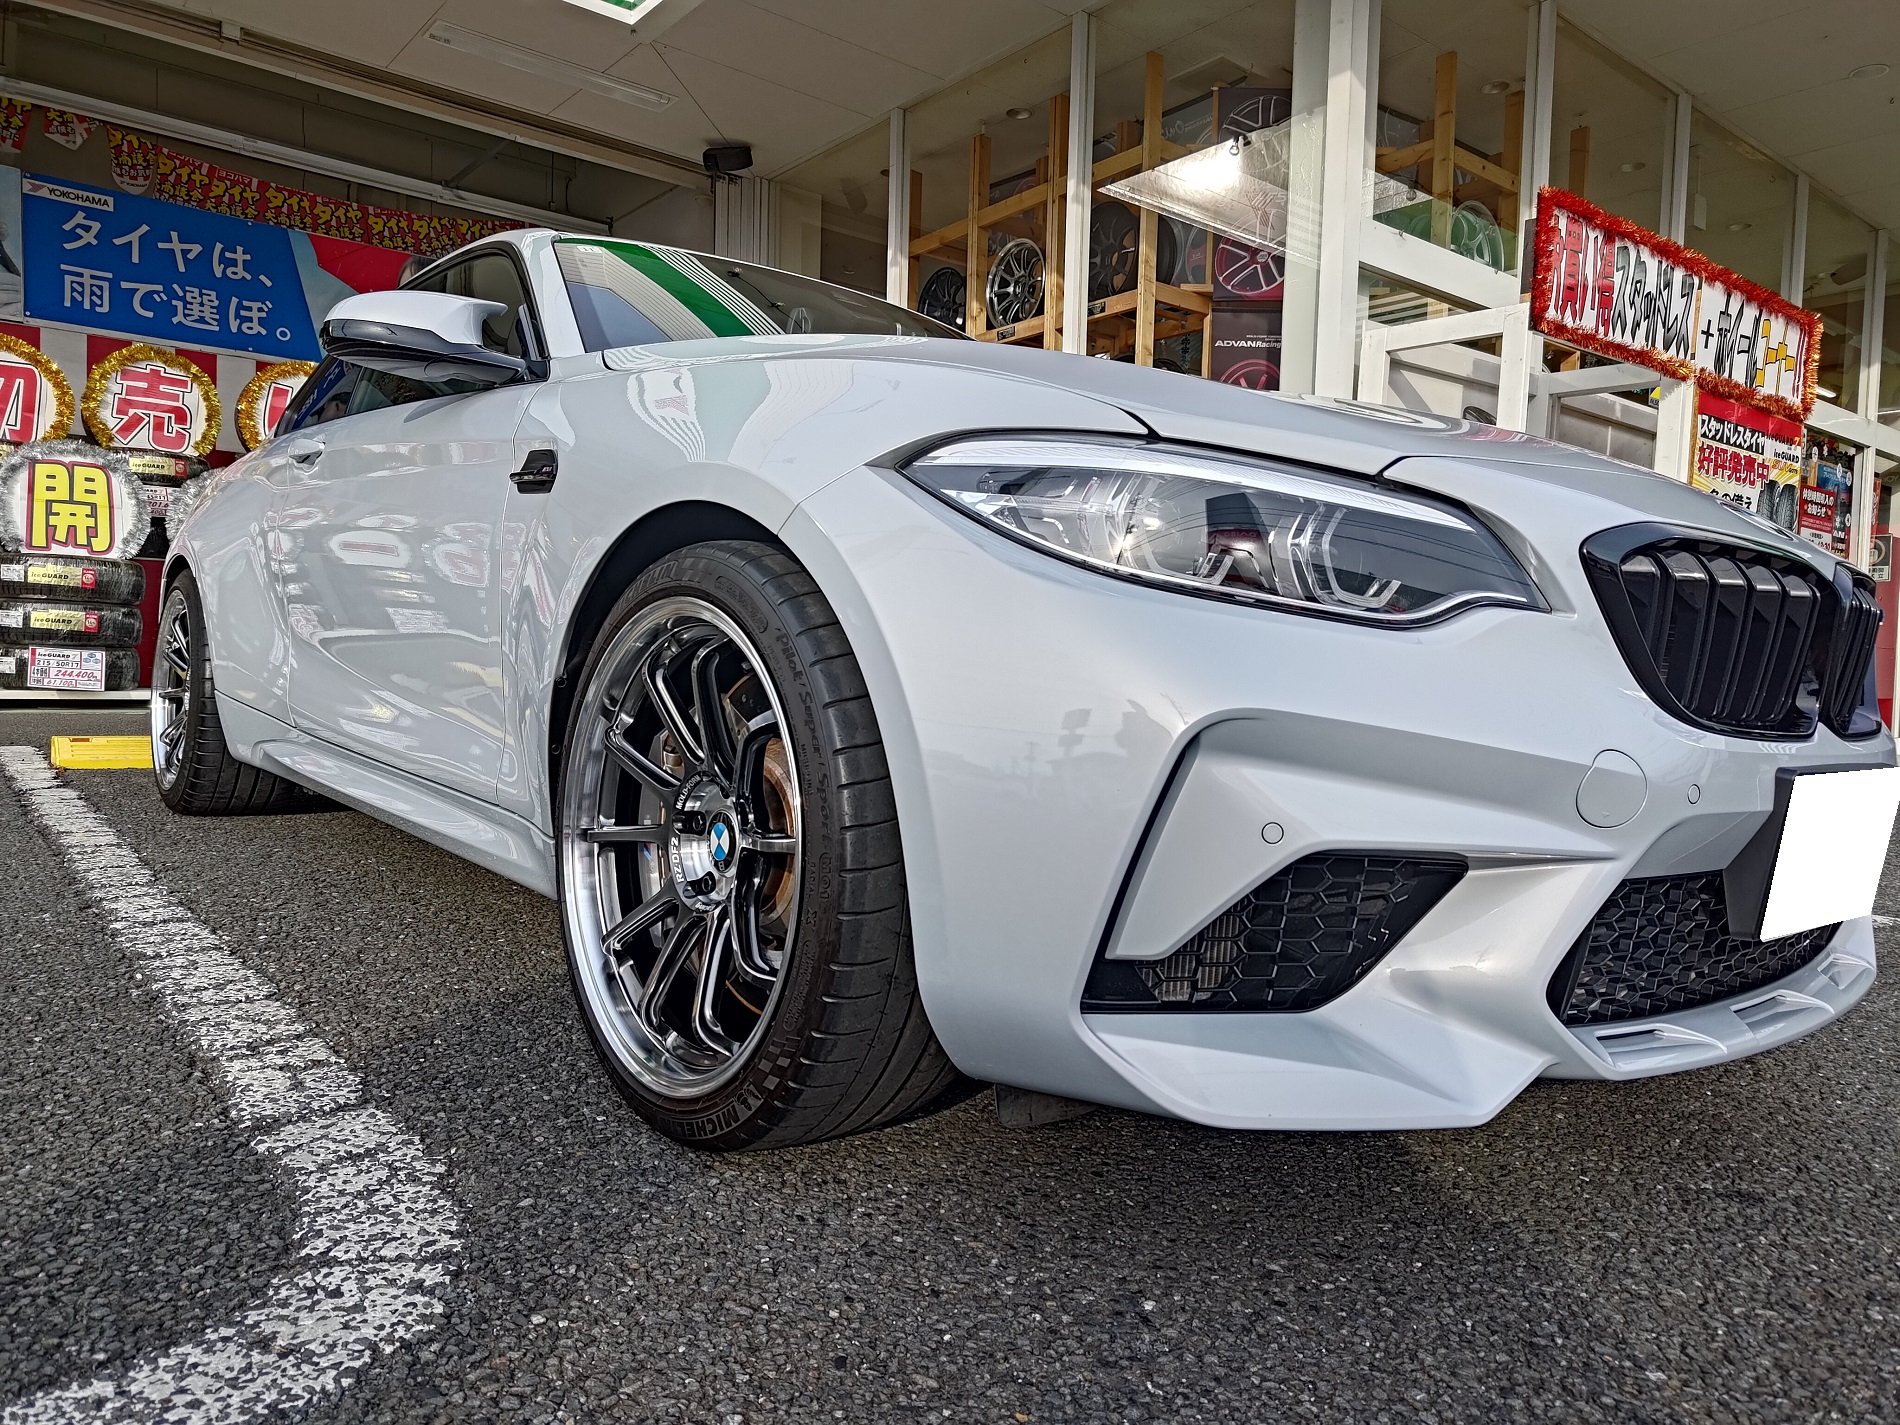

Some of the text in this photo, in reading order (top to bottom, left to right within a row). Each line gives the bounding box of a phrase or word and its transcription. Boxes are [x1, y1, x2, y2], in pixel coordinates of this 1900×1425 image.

[218, 169, 250, 183] ヨコハマ
[47, 187, 109, 208] YOKOHAMA
[209, 179, 261, 205] タイヤ
[313, 203, 363, 225] タイヤ
[61, 210, 272, 288] タイヤは、
[60, 263, 291, 342] 雨で選ぼ。
[112, 364, 191, 452] 売
[1700, 414, 1766, 455] スタッドレスタイヤ
[132, 462, 165, 470] iceGUARD
[1697, 440, 1771, 491] 好評発売中
[1773, 448, 1800, 464] iceGUARD
[28, 459, 114, 555] 開
[31, 572, 69, 580] iceGUARD
[33, 617, 73, 625] iceGUARD
[37, 651, 71, 659] iceGUARD
